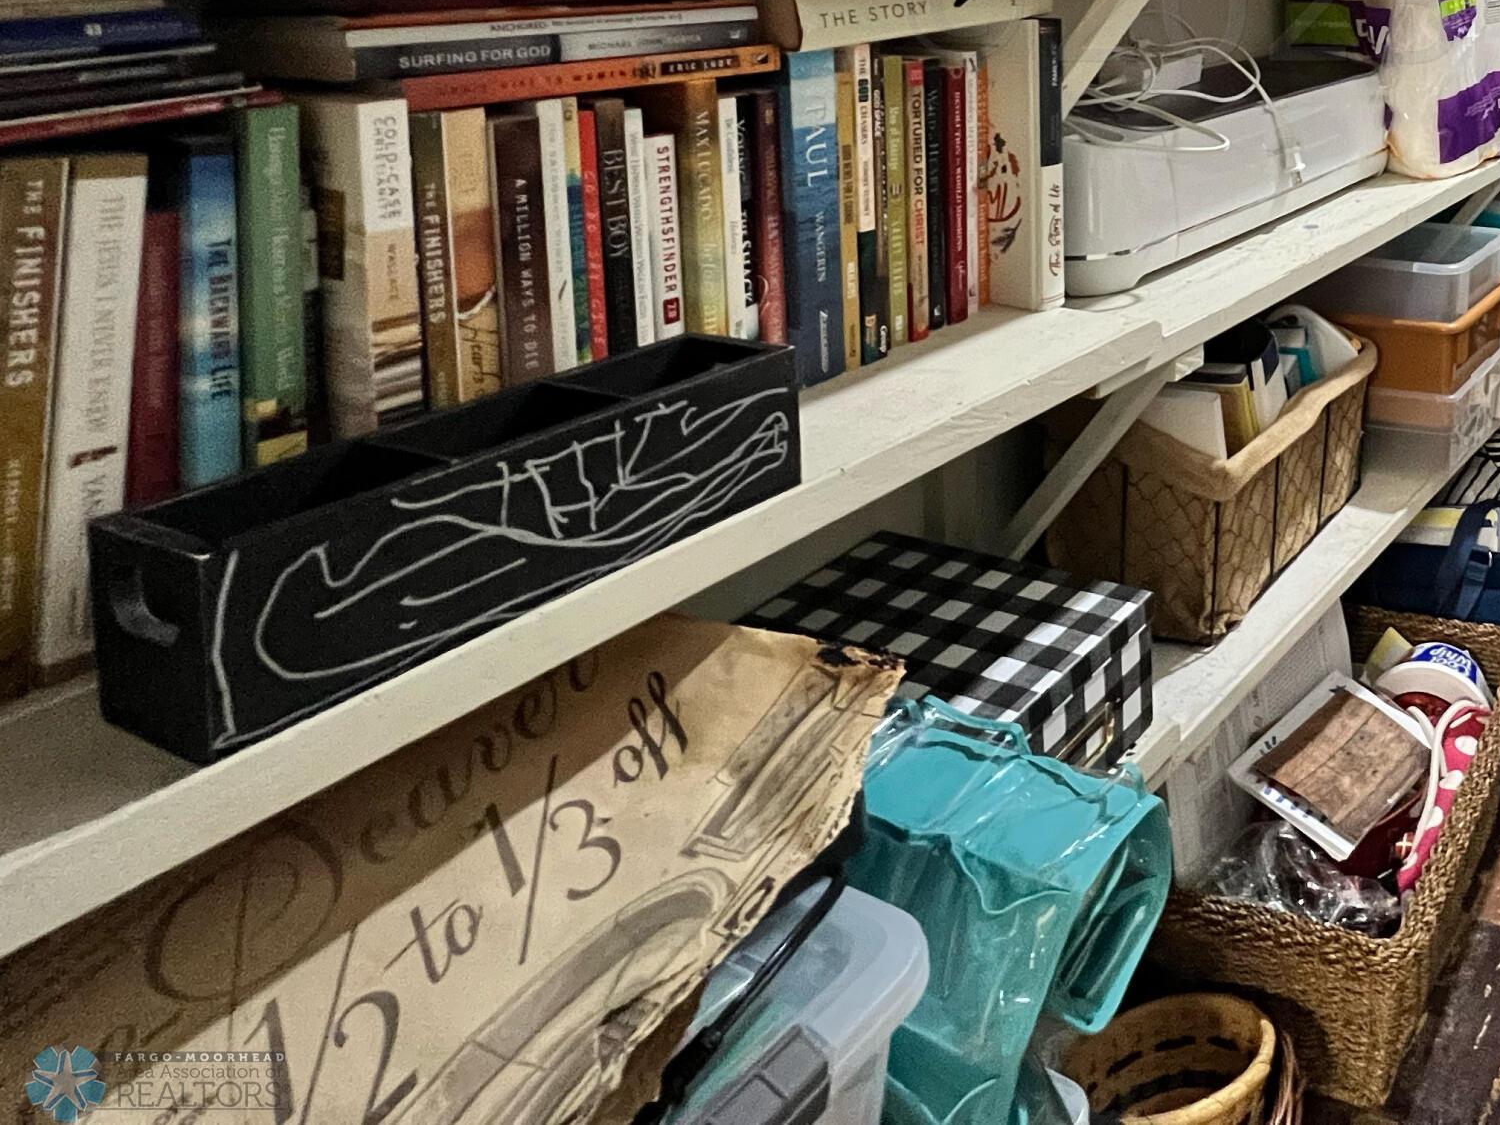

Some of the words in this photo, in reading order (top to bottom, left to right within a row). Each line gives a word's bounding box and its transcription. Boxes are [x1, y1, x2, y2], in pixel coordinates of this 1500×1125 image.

[820, 9, 858, 29] THE
[869, 0, 928, 22] STORY
[399, 48, 477, 70] SURFING
[481, 46, 514, 63] FOR
[516, 43, 552, 61] GOD
[856, 59, 867, 75] THE
[695, 111, 711, 148] MAX
[803, 101, 829, 190] PAUL
[859, 105, 869, 145] CHASERS
[911, 92, 923, 164] TORTURED
[22, 179, 43, 216] THE
[515, 178, 528, 189] A
[601, 149, 626, 207] BEST
[914, 168, 924, 196] FOR
[514, 194, 531, 263] MILLION
[606, 216, 629, 260] BOY
[656, 145, 679, 294] STRENGTHSFINDER
[914, 199, 925, 246] CHRIST
[813, 211, 827, 283] WANGERIN
[423, 213, 446, 325] FINISHERS
[520, 267, 533, 308] WAYS
[7, 225, 46, 389] FINISHERS
[523, 316, 537, 336] TO
[524, 341, 540, 372] DIE
[210, 365, 235, 401] LIFE
[383, 897, 484, 984] to
[472, 753, 622, 966] 1/3
[612, 671, 690, 783] off
